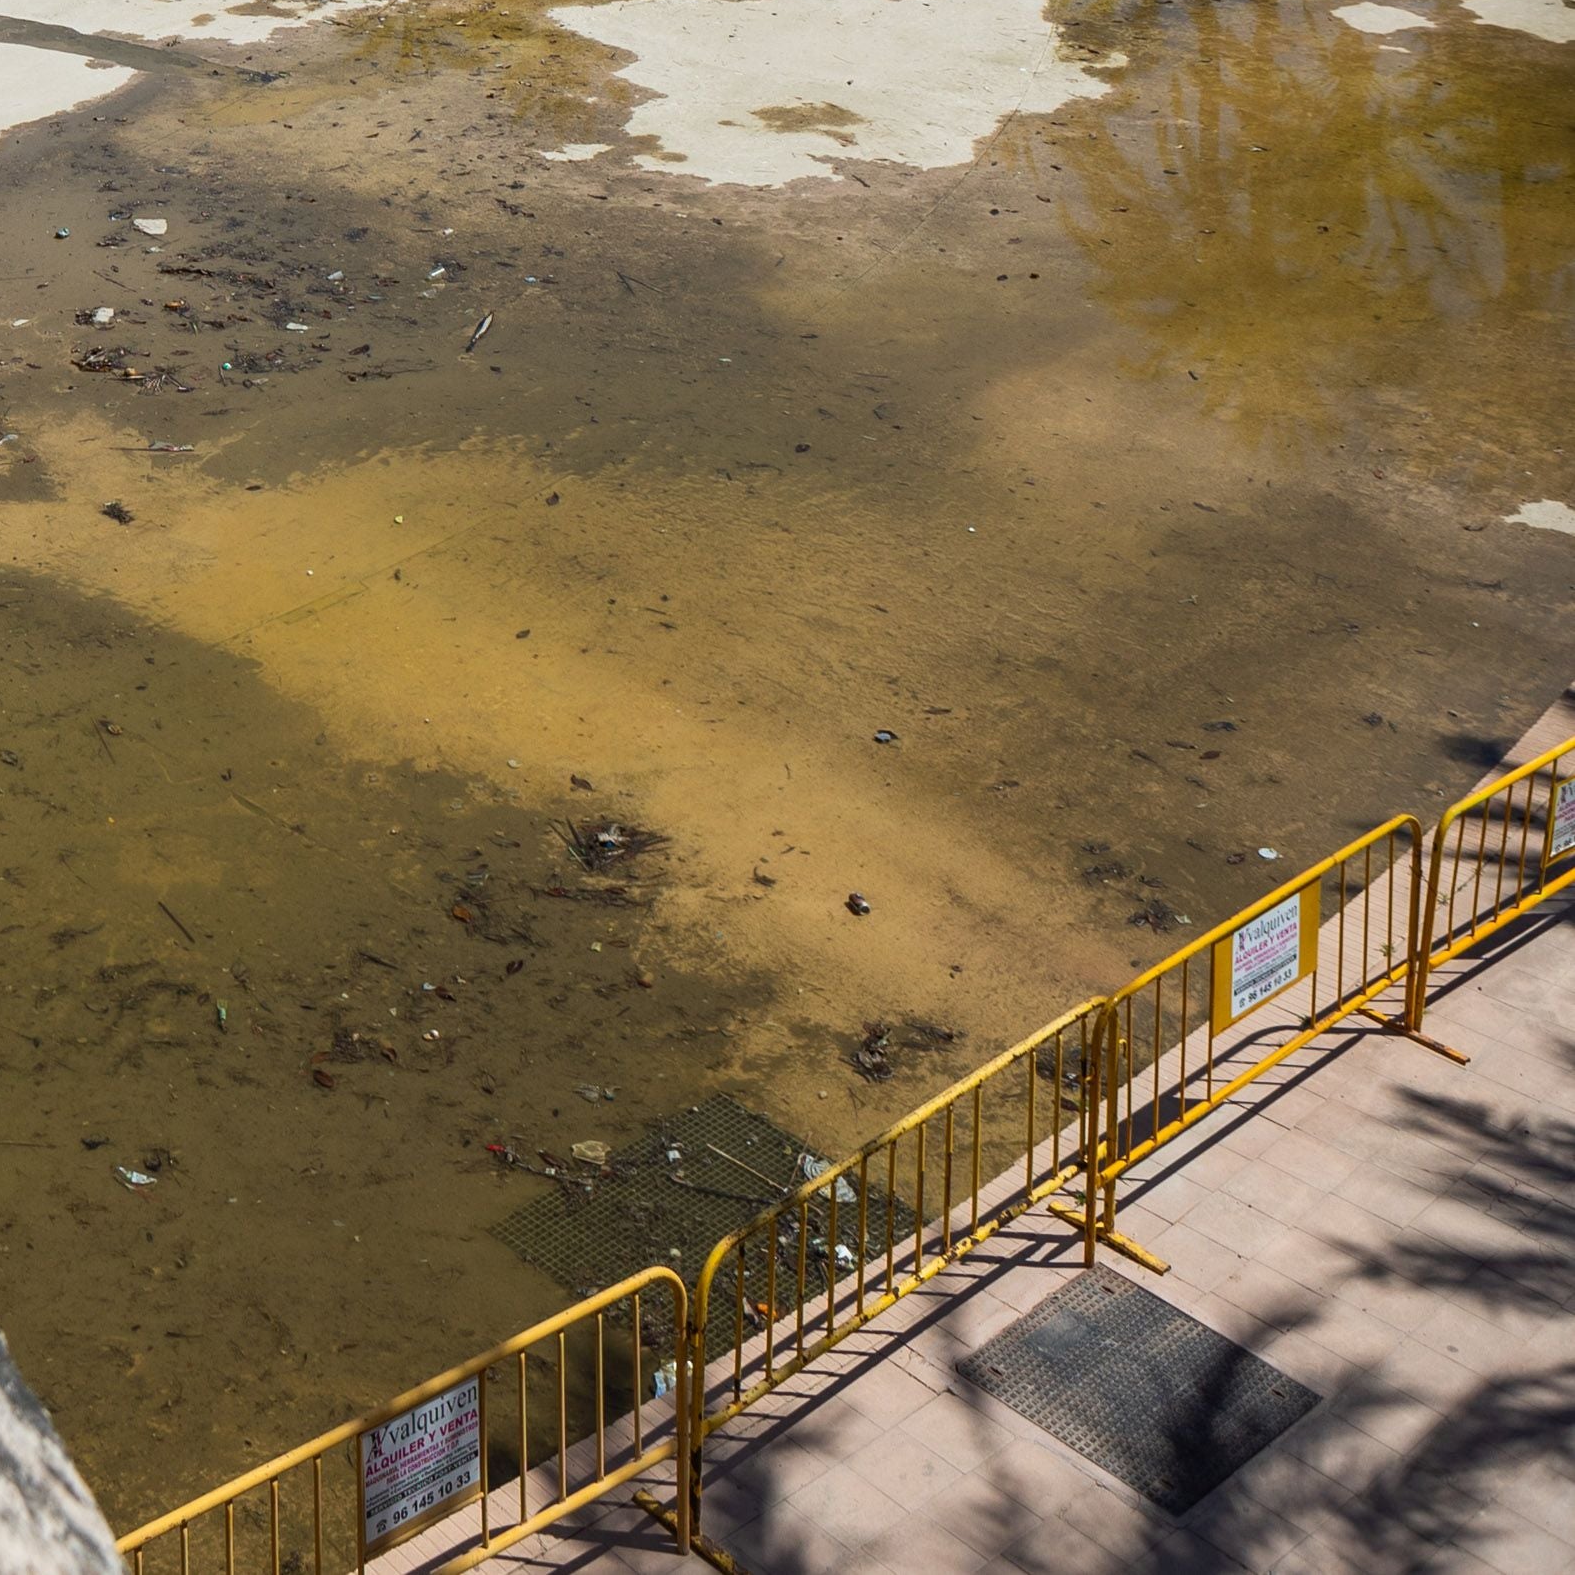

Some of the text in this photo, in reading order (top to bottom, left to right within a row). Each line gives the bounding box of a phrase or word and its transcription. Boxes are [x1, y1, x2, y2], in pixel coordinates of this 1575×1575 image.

[365, 1436, 424, 1478] ALQUILER
[428, 1430, 435, 1442] Y
[439, 1408, 477, 1436] VENTA
[389, 1386, 477, 1444] valquiven
[393, 1507, 408, 1524] 96
[412, 1491, 433, 1512] 145
[438, 1481, 452, 1497] 10
[457, 1471, 470, 1487] 33
